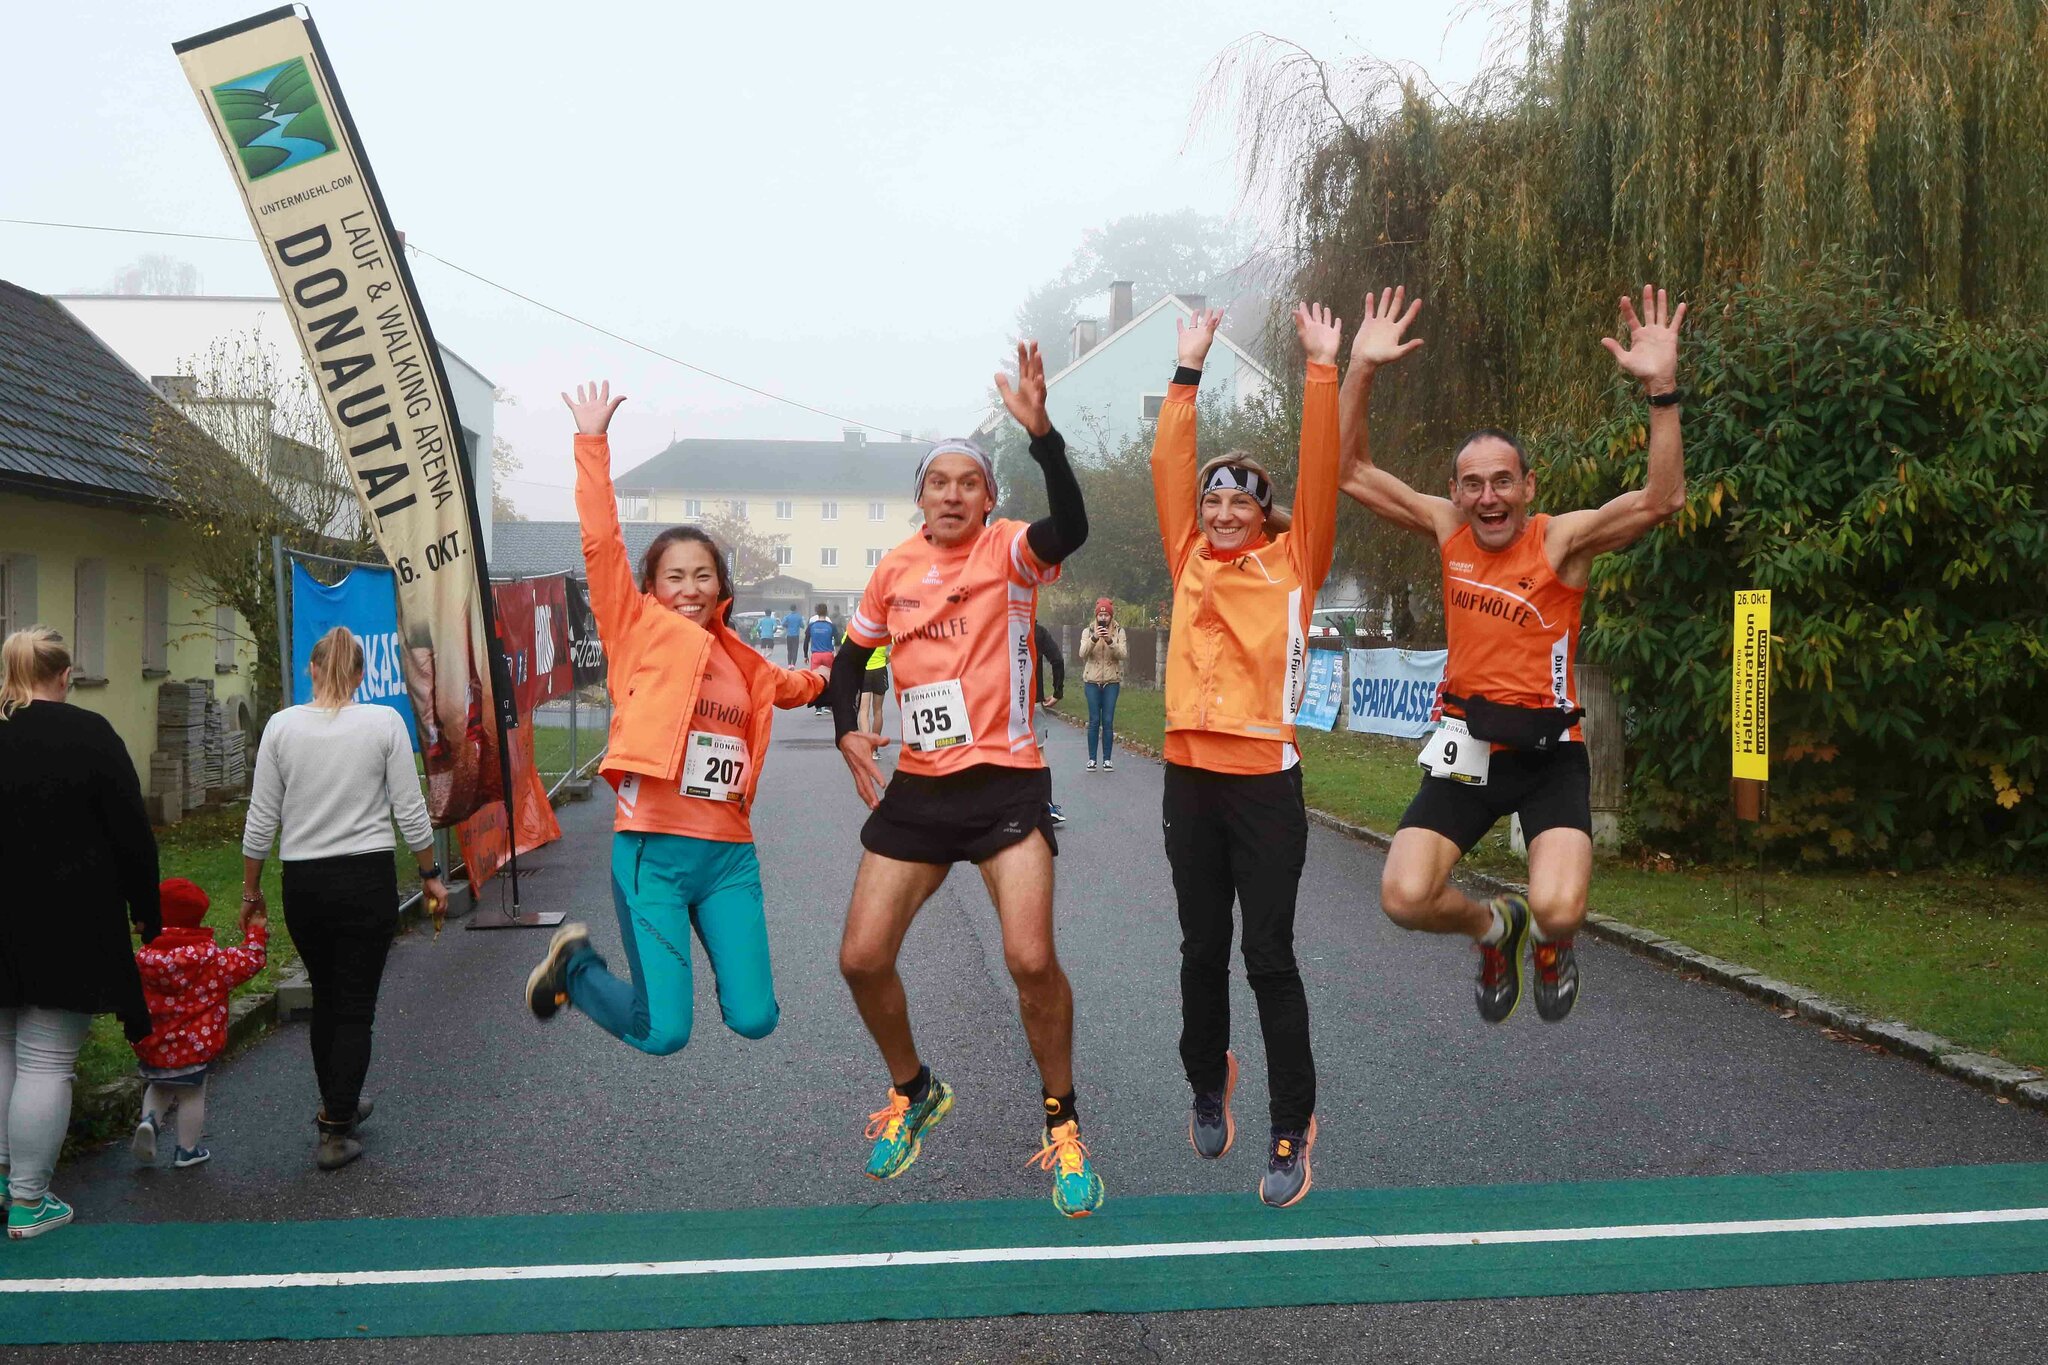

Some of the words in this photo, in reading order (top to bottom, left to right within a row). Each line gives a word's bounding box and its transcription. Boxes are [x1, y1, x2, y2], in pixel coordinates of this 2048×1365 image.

[260, 175, 353, 215] UNTERMUEHL.COM
[340, 210, 384, 271] LAUF
[366, 281, 392, 303] &
[274, 224, 417, 533] DONAUTAL
[376, 304, 431, 419] WALKING
[413, 424, 454, 510] ARENA
[395, 557, 421, 586] 6.
[425, 530, 466, 571] OKT.
[1451, 588, 1532, 628] LAUFWÖLFE
[1737, 593, 1749, 605] 26.
[1751, 593, 1768, 605] Okt.
[894, 617, 968, 644] WÖLFE
[352, 632, 408, 702] RKAS
[1555, 656, 1563, 674] DJK
[1743, 613, 1755, 753] Halbmarathon
[1352, 678, 1435, 722] SPARKASSE
[1757, 632, 1767, 752] untermuehl.com
[911, 706, 952, 735] 135
[704, 757, 744, 786] 207
[1443, 741, 1458, 765] 9
